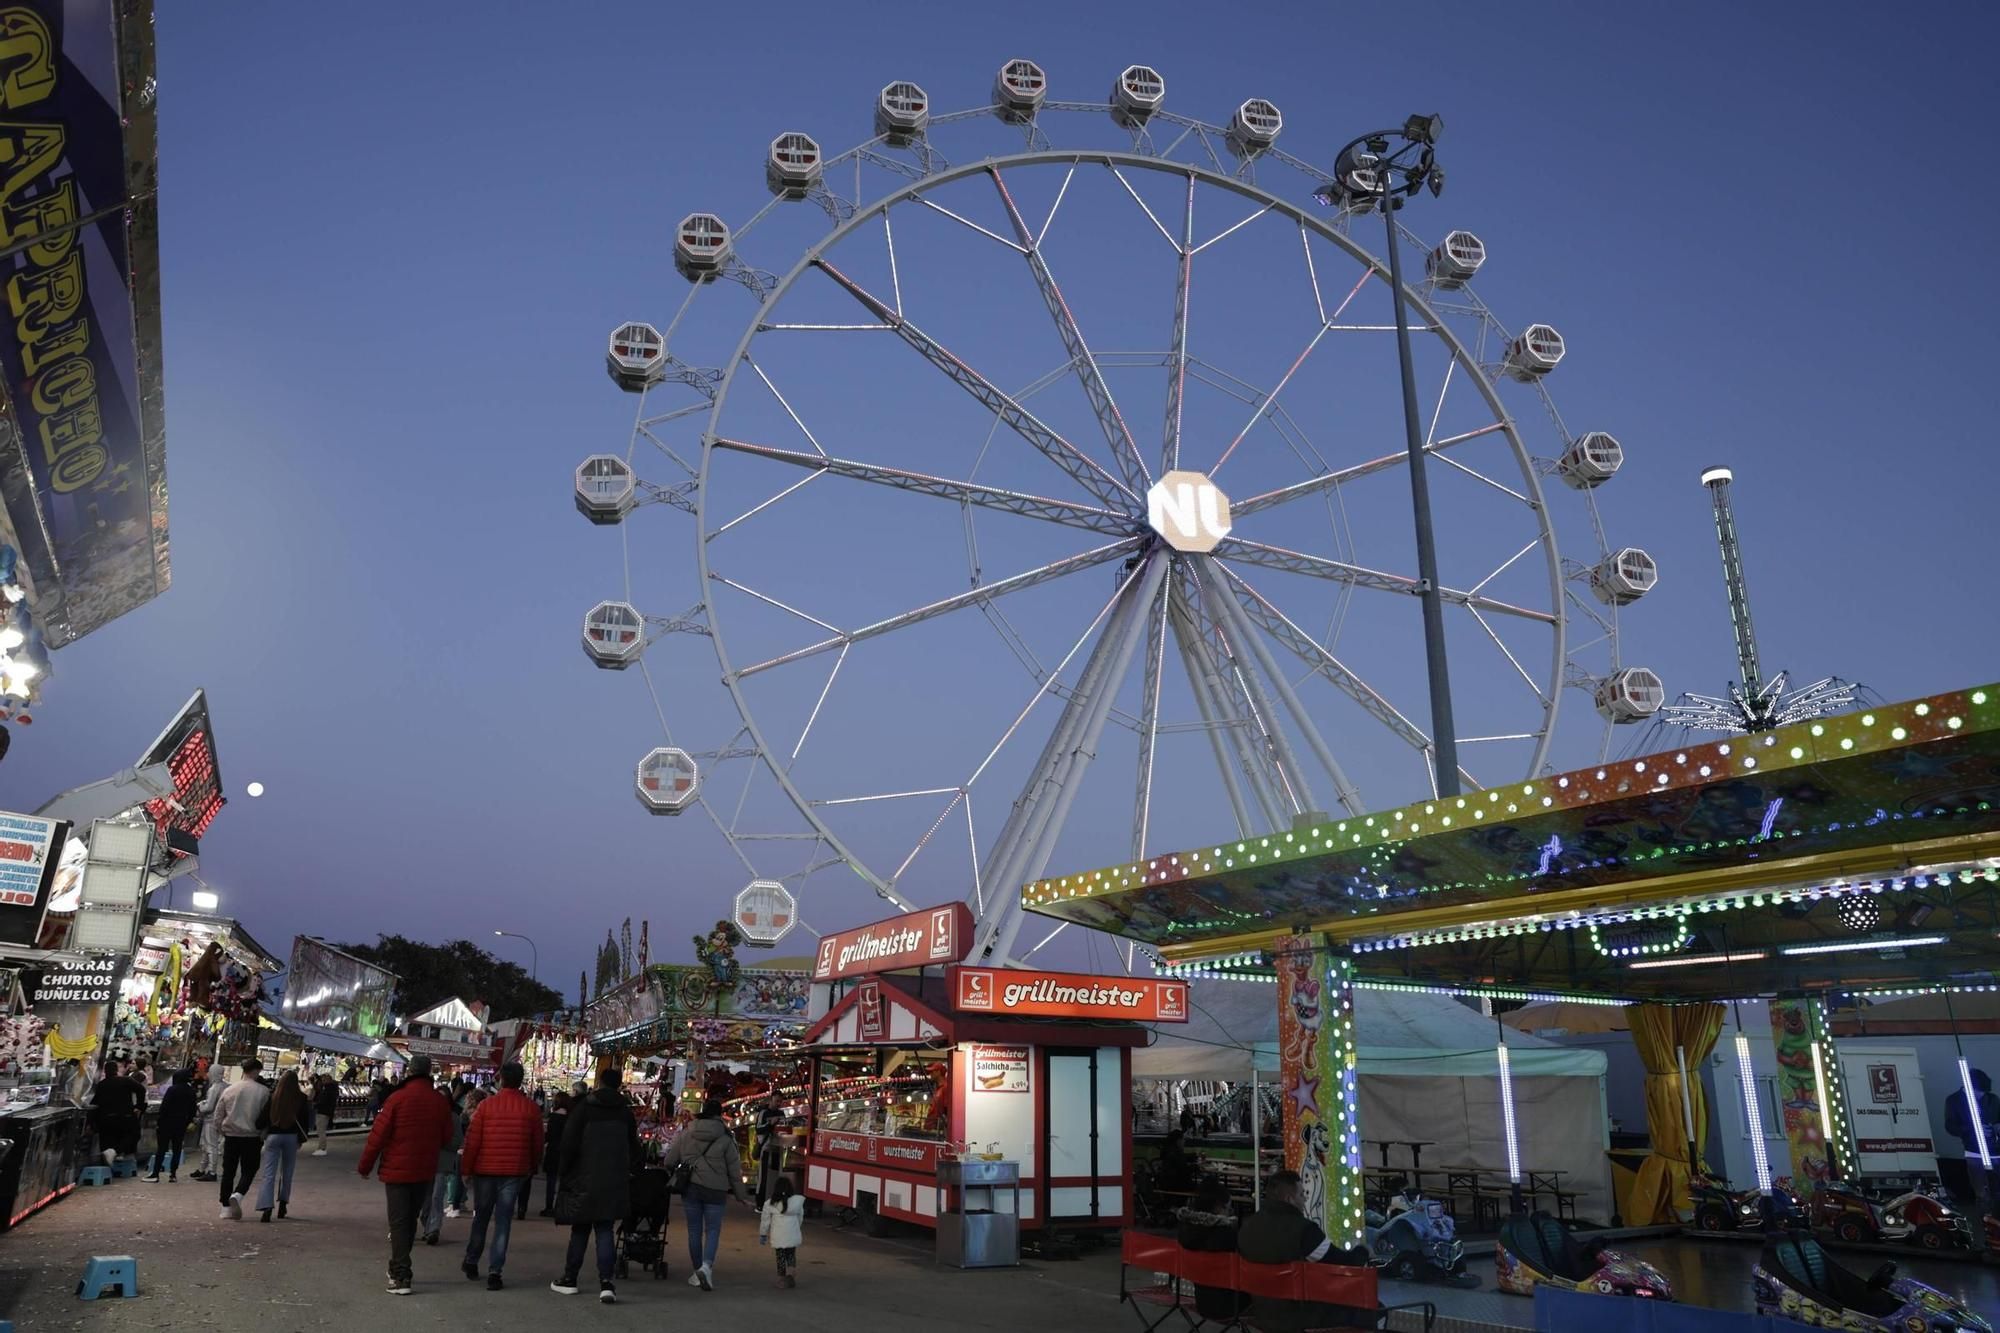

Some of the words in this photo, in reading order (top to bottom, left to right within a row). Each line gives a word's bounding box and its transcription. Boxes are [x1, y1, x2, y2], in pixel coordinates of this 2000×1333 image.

[0, 4, 109, 497] CAPRICHO
[838, 928, 923, 971] grillmeister
[54, 959, 115, 971] ORRAS
[42, 974, 113, 986] CHURROS
[34, 986, 111, 1001] BUÑUELOS
[969, 991, 983, 999] grill
[1003, 979, 1144, 1008] grillmeister
[1164, 1002, 1176, 1010] grill
[976, 1062, 1010, 1071] Salchicha
[829, 1137, 861, 1151] grillmeister
[1865, 1142, 1927, 1152] www.grillmeister.com
[883, 1144, 925, 1161] wurstmeister
[1601, 1281, 1609, 1291] 7
